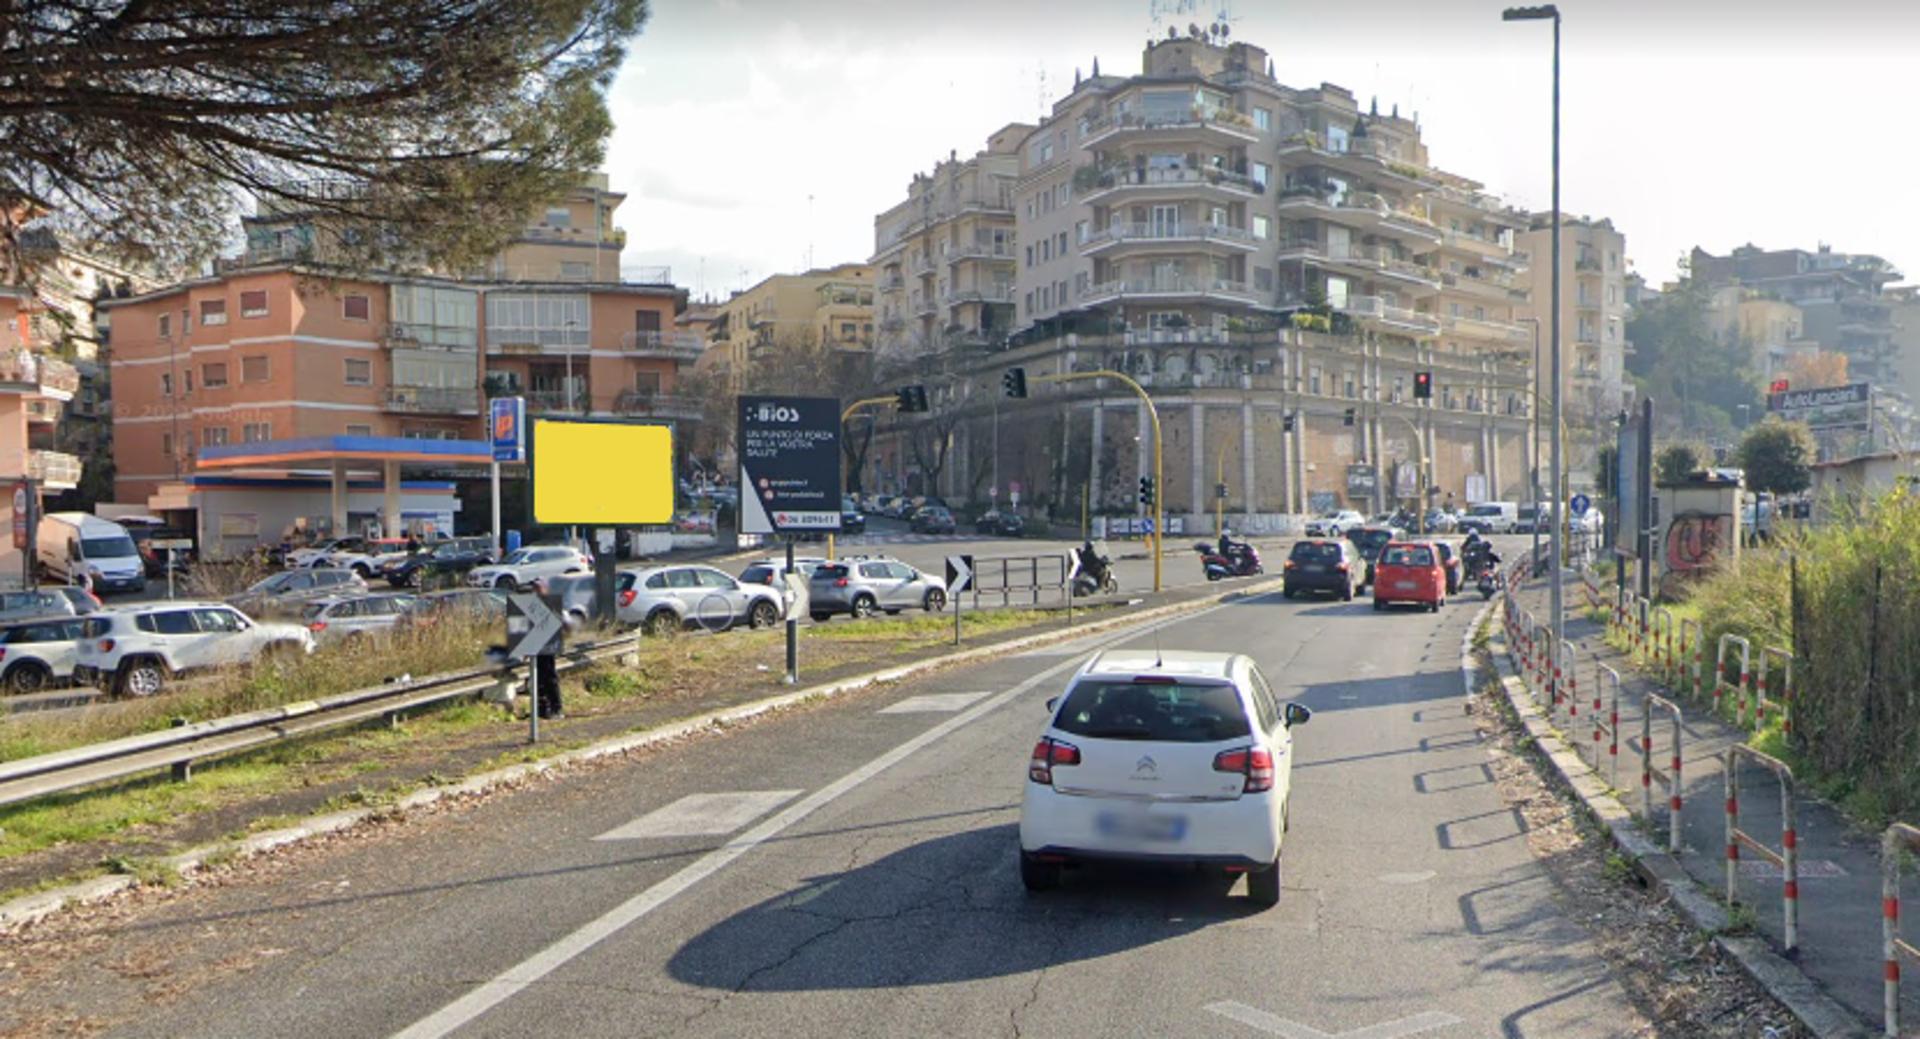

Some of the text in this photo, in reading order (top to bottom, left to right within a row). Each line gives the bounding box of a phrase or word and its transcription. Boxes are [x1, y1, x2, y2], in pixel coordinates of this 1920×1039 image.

[805, 430, 834, 440] FORZA
[778, 439, 814, 449] VOSTRA
[746, 448, 777, 456] SALUTE
